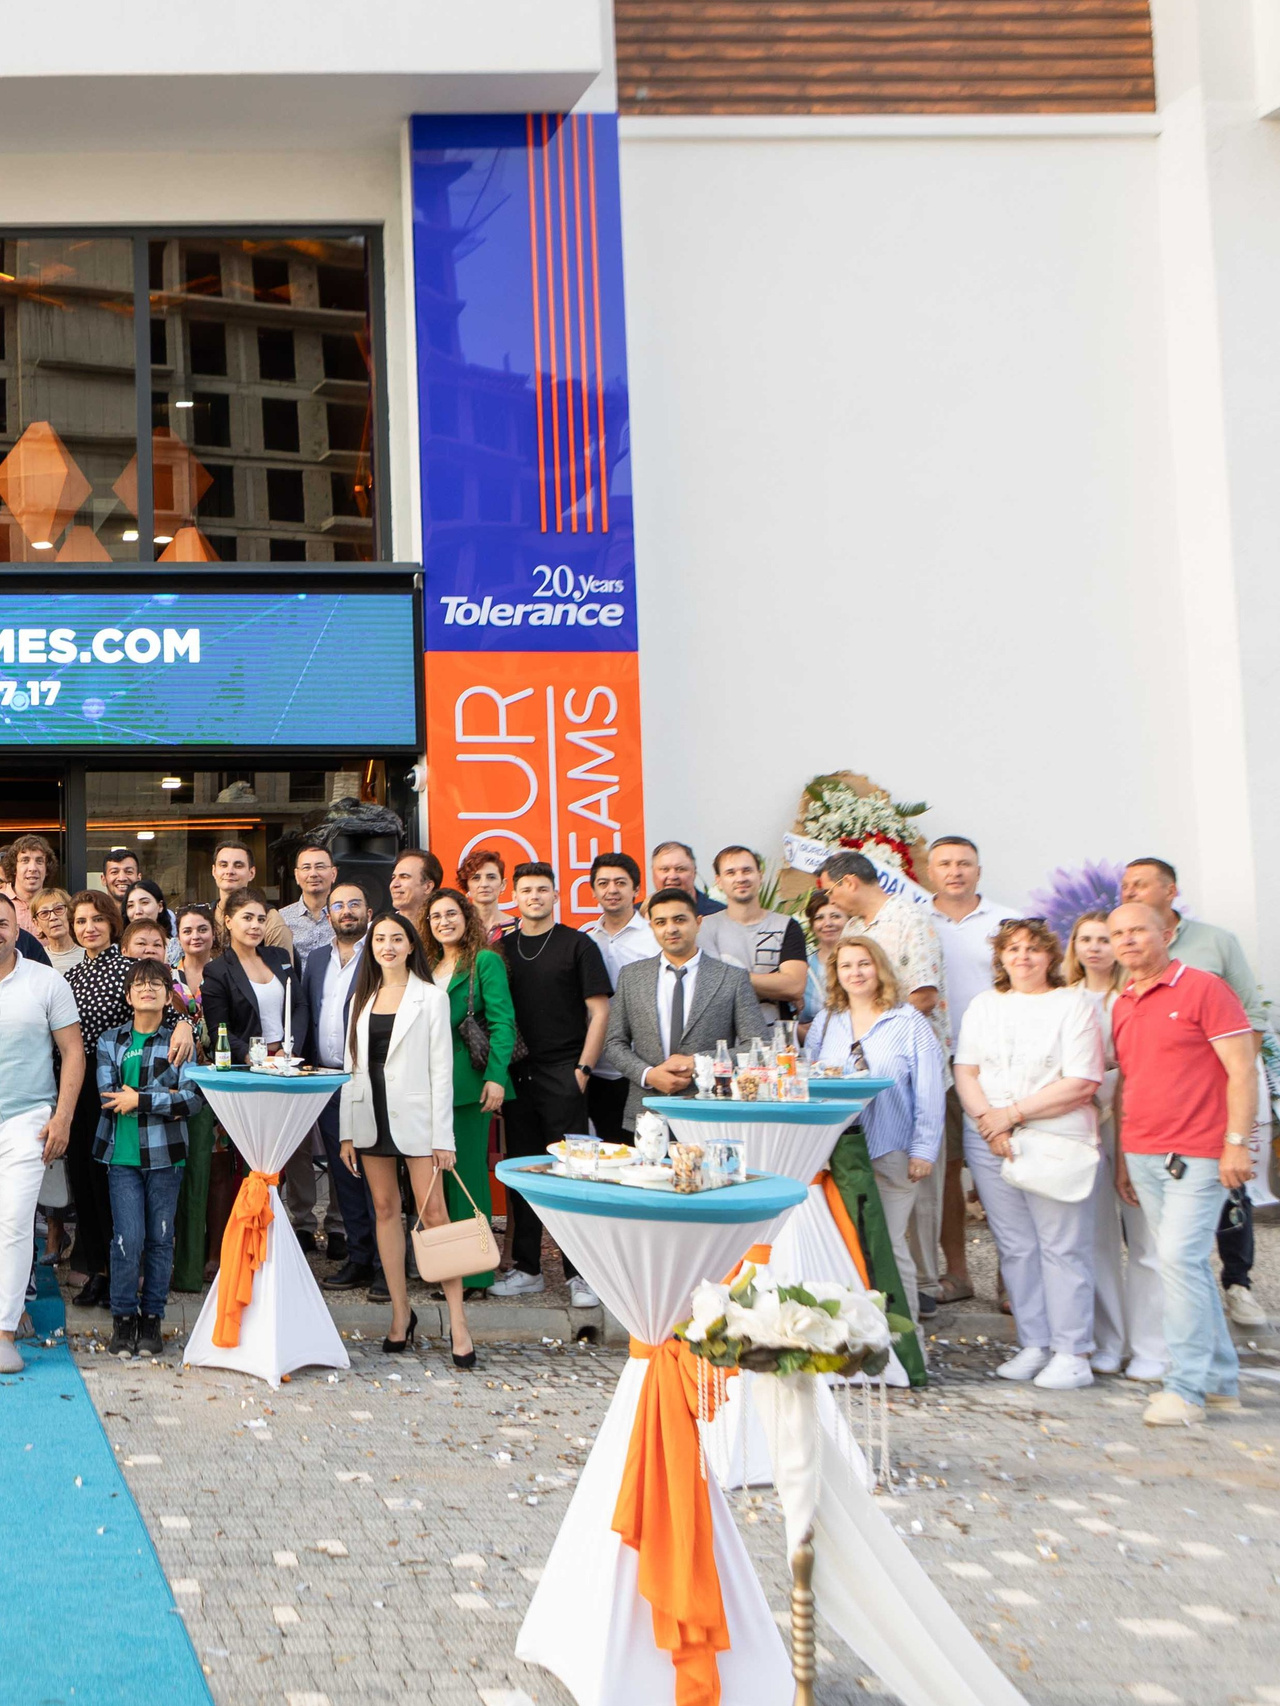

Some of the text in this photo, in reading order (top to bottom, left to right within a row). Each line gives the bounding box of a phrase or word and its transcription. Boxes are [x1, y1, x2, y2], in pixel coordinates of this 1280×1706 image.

[532, 564, 575, 598] 20
[440, 596, 625, 627] Tolerance
[26, 681, 62, 706] 17
